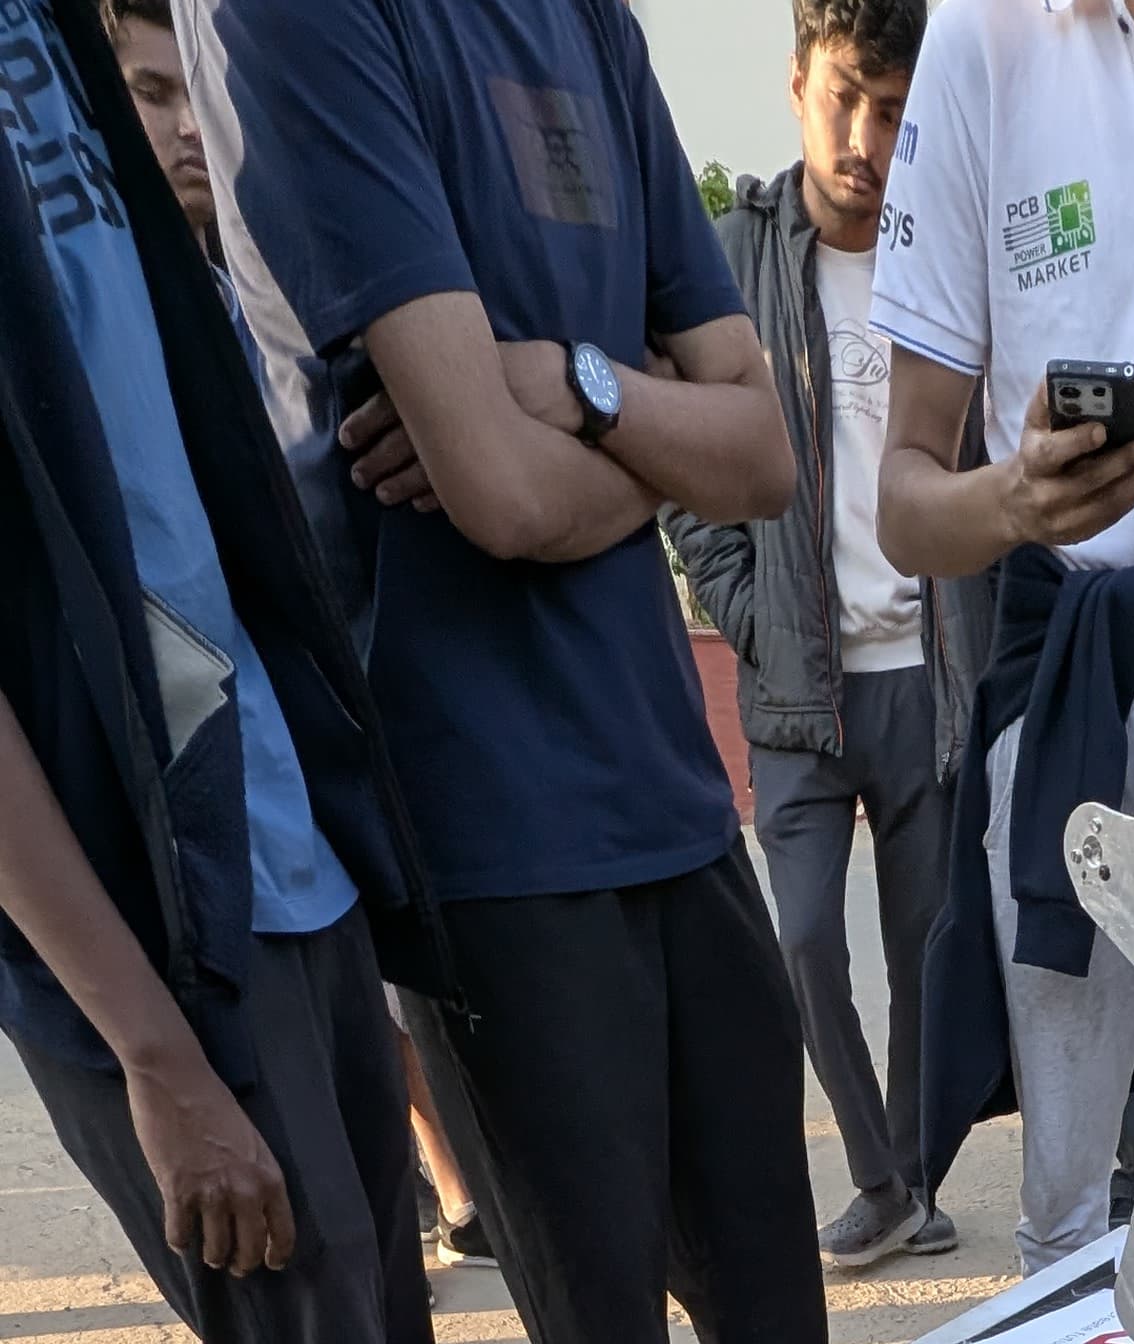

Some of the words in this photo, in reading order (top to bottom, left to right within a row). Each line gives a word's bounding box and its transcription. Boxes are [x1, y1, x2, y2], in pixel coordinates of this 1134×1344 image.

[1006, 195, 1040, 224] PCB
[1013, 243, 1047, 264] POWER
[1017, 250, 1091, 292] MARKET
